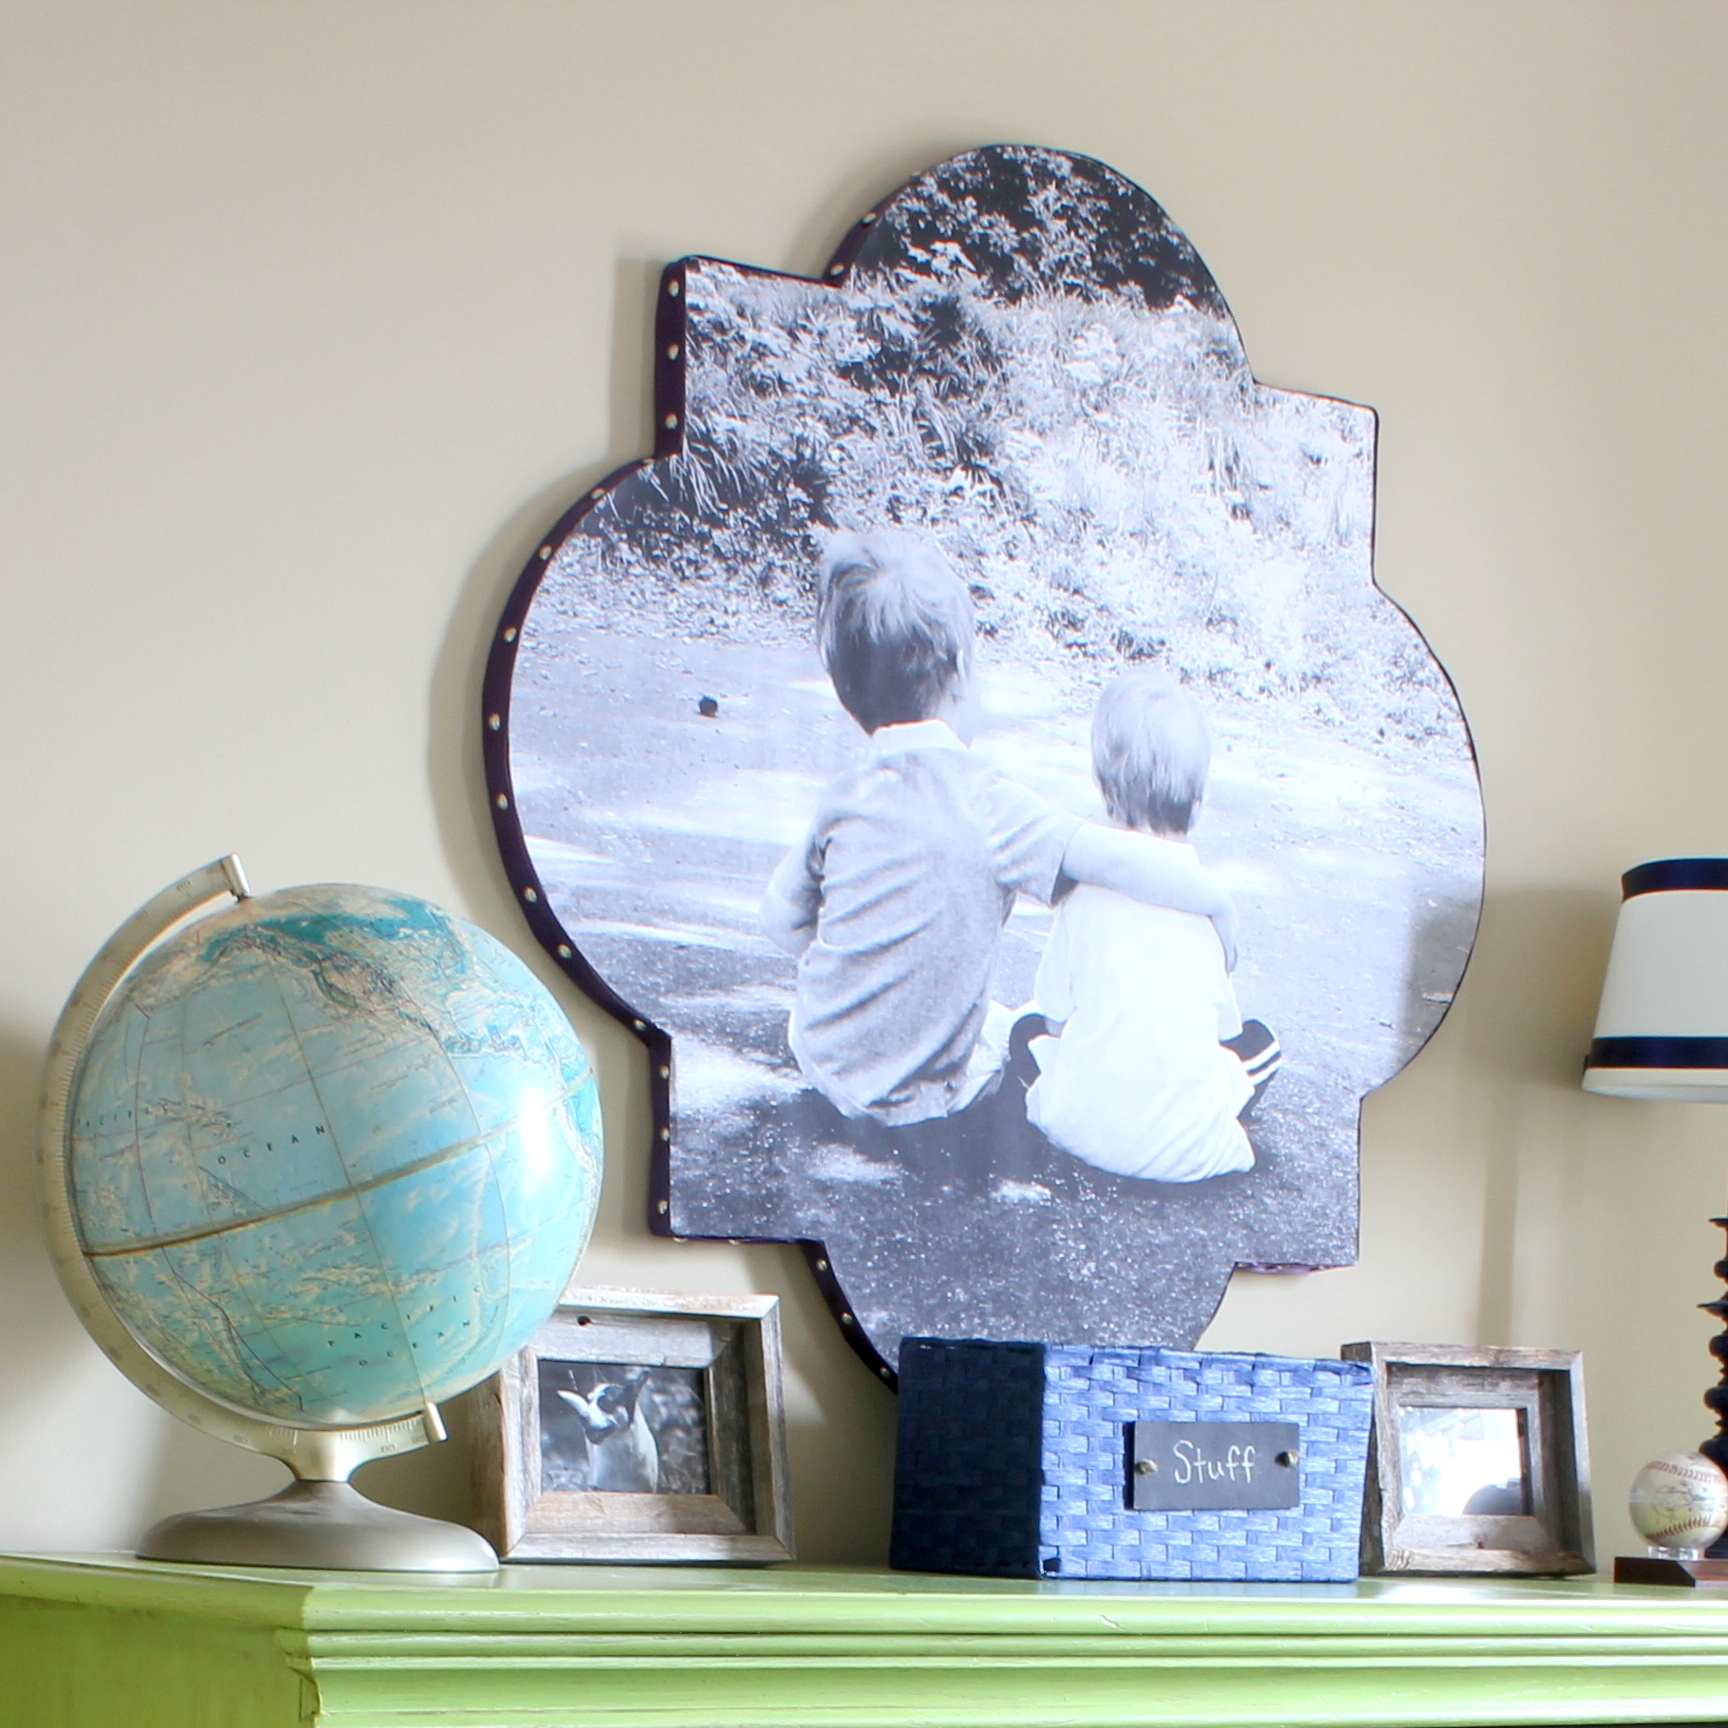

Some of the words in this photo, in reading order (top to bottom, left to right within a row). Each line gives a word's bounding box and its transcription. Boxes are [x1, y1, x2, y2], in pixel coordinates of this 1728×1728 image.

[217, 1124, 326, 1166] OCEAN
[358, 1319, 471, 1367] OCEAN
[1172, 1438, 1257, 1485] Stuff
